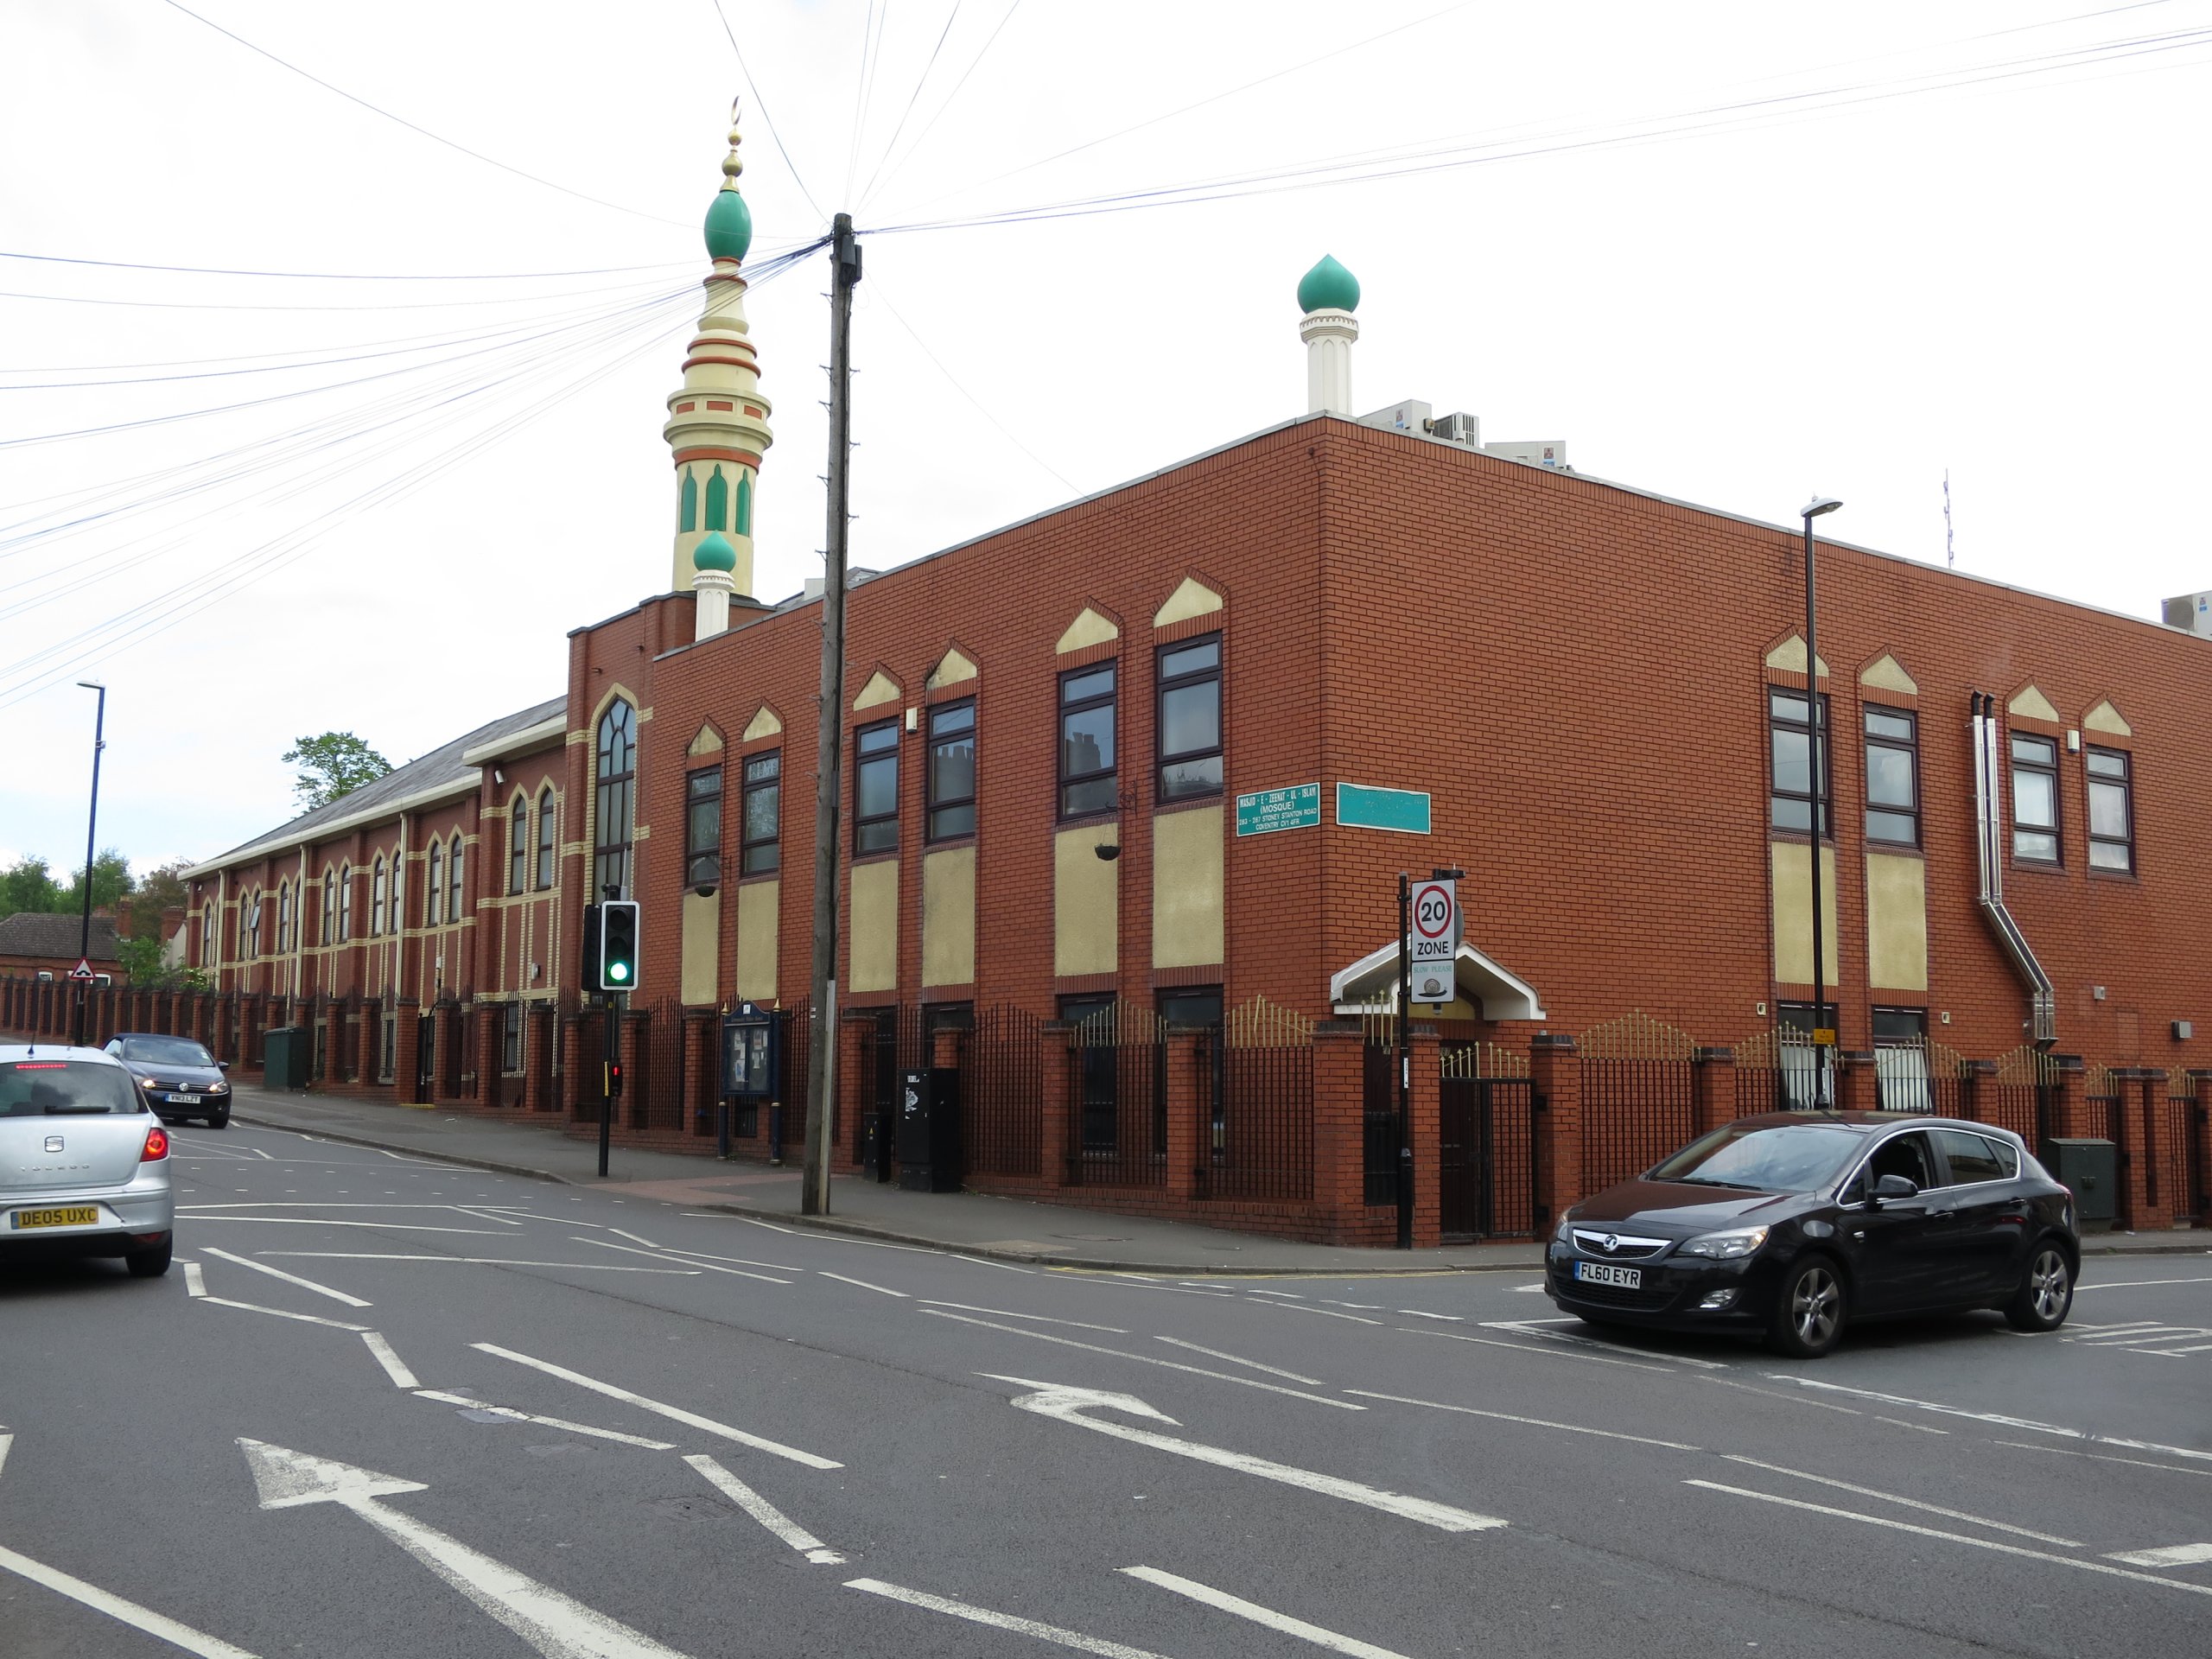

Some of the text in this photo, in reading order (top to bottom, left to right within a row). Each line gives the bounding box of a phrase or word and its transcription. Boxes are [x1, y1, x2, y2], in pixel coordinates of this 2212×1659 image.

[1239, 797, 1256, 808] MASJID
[1261, 795, 1264, 804] E
[1268, 791, 1286, 804] ZEENAT
[1290, 790, 1297, 799] UL
[1301, 786, 1316, 798] ISLAM
[1260, 801, 1294, 815] (MOSQUE)
[1262, 813, 1281, 823] STONEY
[1281, 810, 1303, 819] STANTON
[1303, 807, 1317, 816] ROAD
[1255, 821, 1279, 830] COVENTRY
[1421, 901, 1446, 922] 20
[1417, 941, 1449, 956] ZONE
[22, 1208, 97, 1225] DE05 UXC
[1581, 1263, 1640, 1286] FL60 EYR
